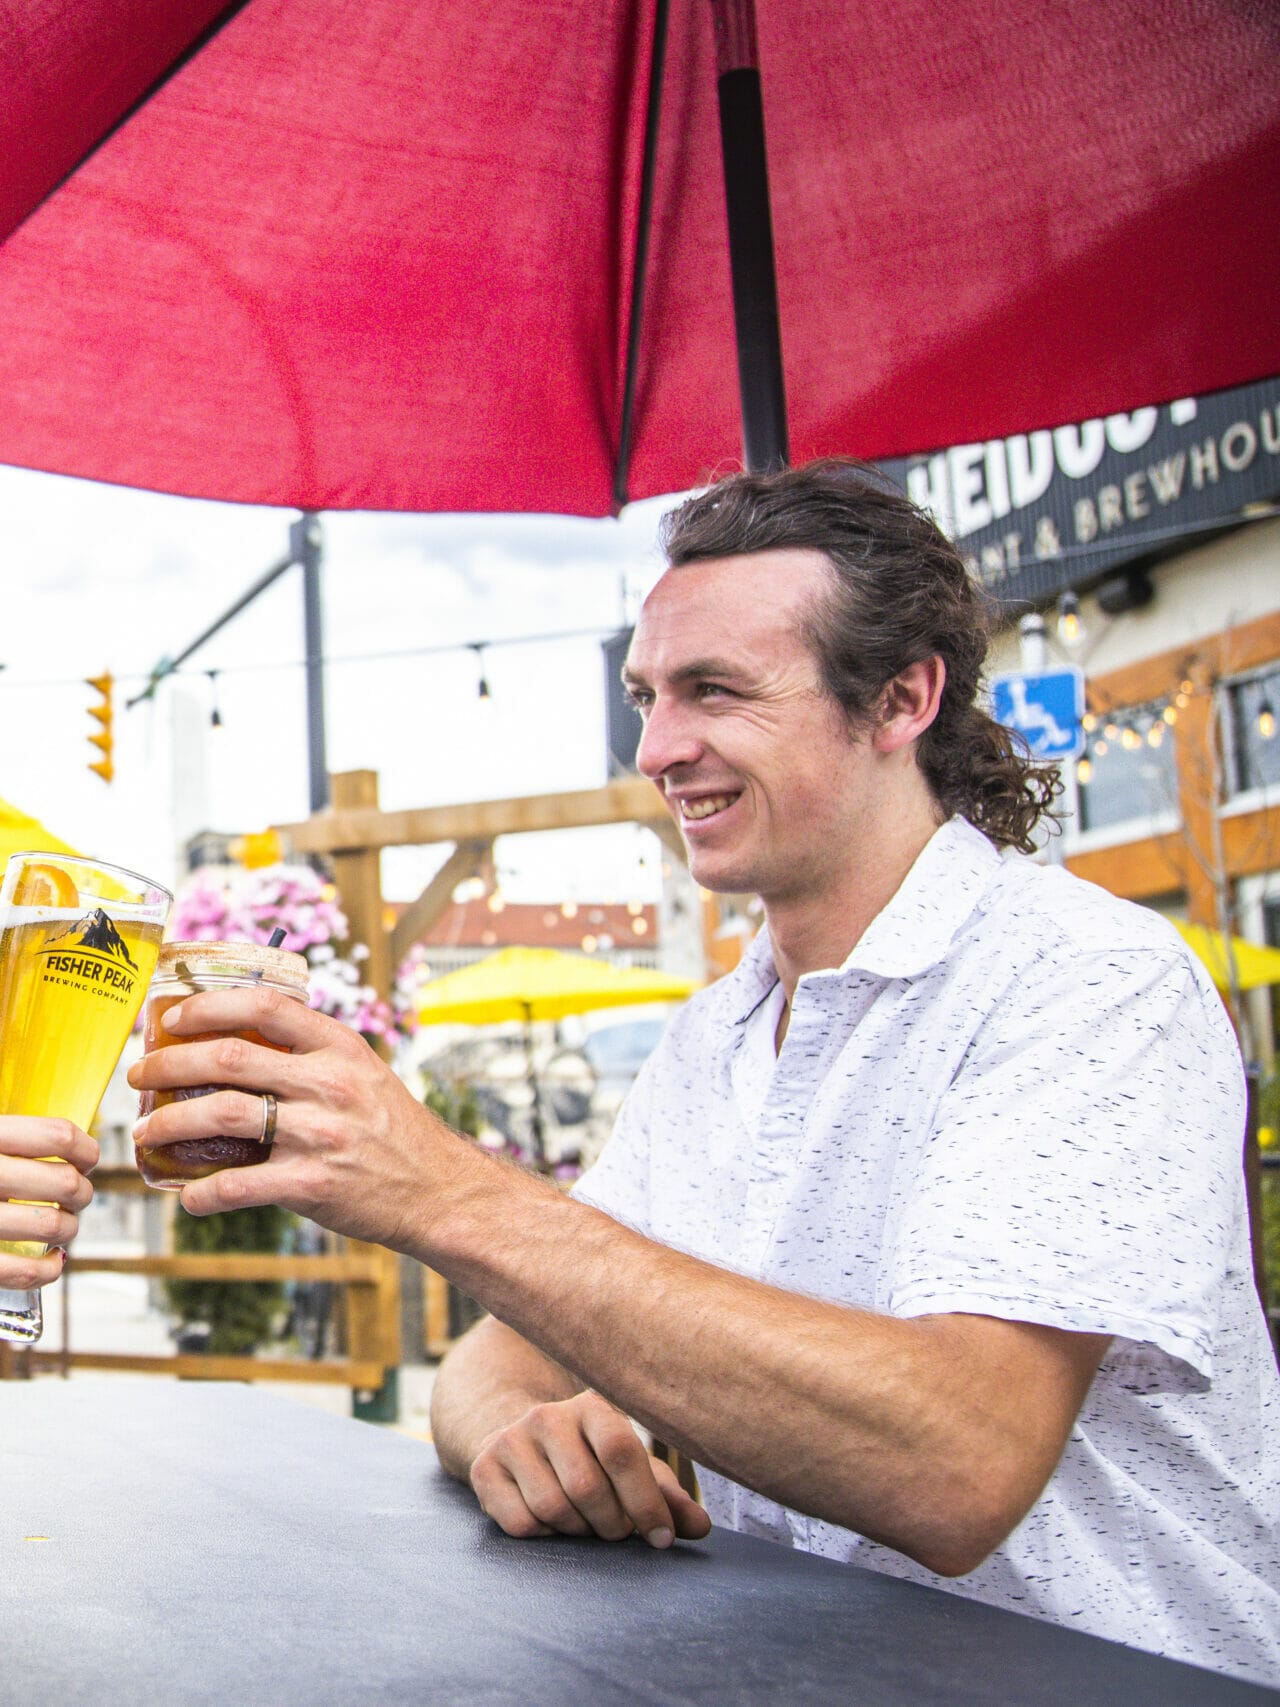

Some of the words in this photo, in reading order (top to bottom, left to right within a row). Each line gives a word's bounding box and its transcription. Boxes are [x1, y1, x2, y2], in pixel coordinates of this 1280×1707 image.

[1034, 516, 1061, 561] &
[43, 974, 88, 991] BREWING
[91, 987, 129, 1005] COMPANY
[46, 955, 103, 981] FISHER
[103, 967, 134, 993] PEAK
